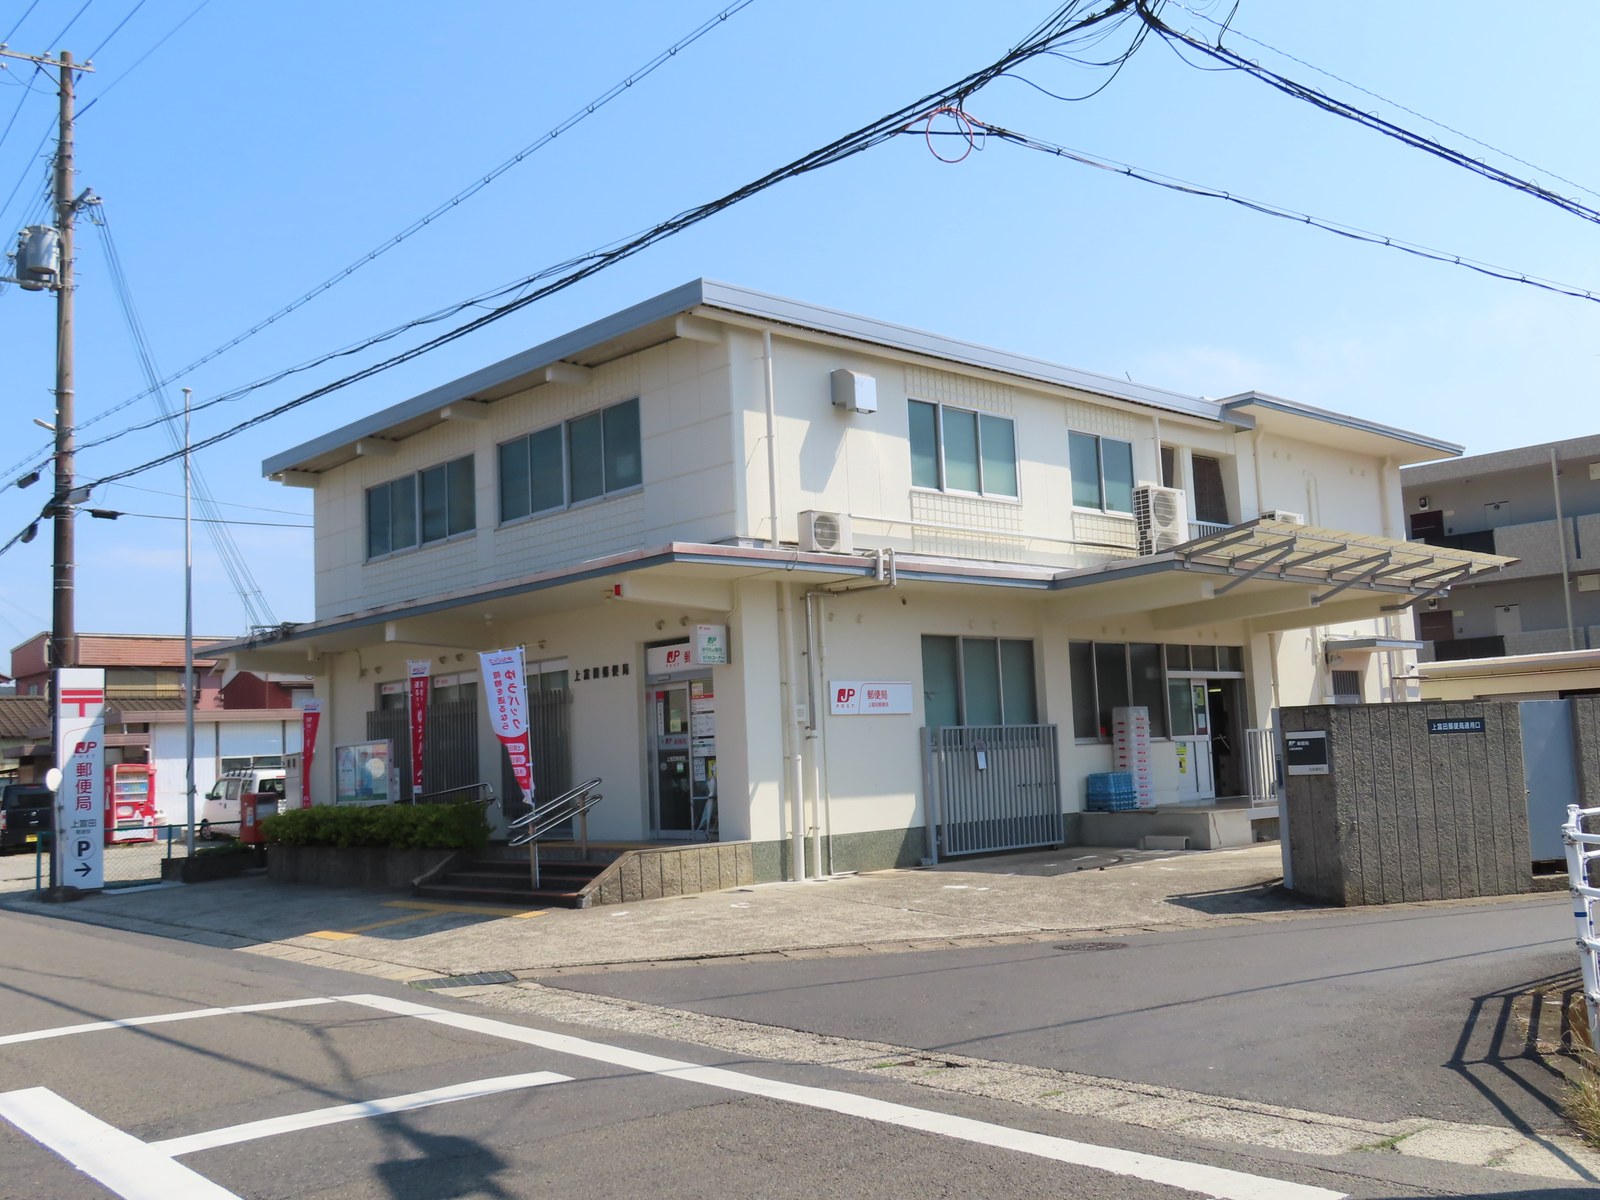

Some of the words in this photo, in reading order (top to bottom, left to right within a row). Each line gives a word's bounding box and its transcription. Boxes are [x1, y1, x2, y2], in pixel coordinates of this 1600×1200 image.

[867, 690, 888, 700] 郵便局
[75, 762, 93, 811] 郵便局
[77, 840, 91, 857] P
